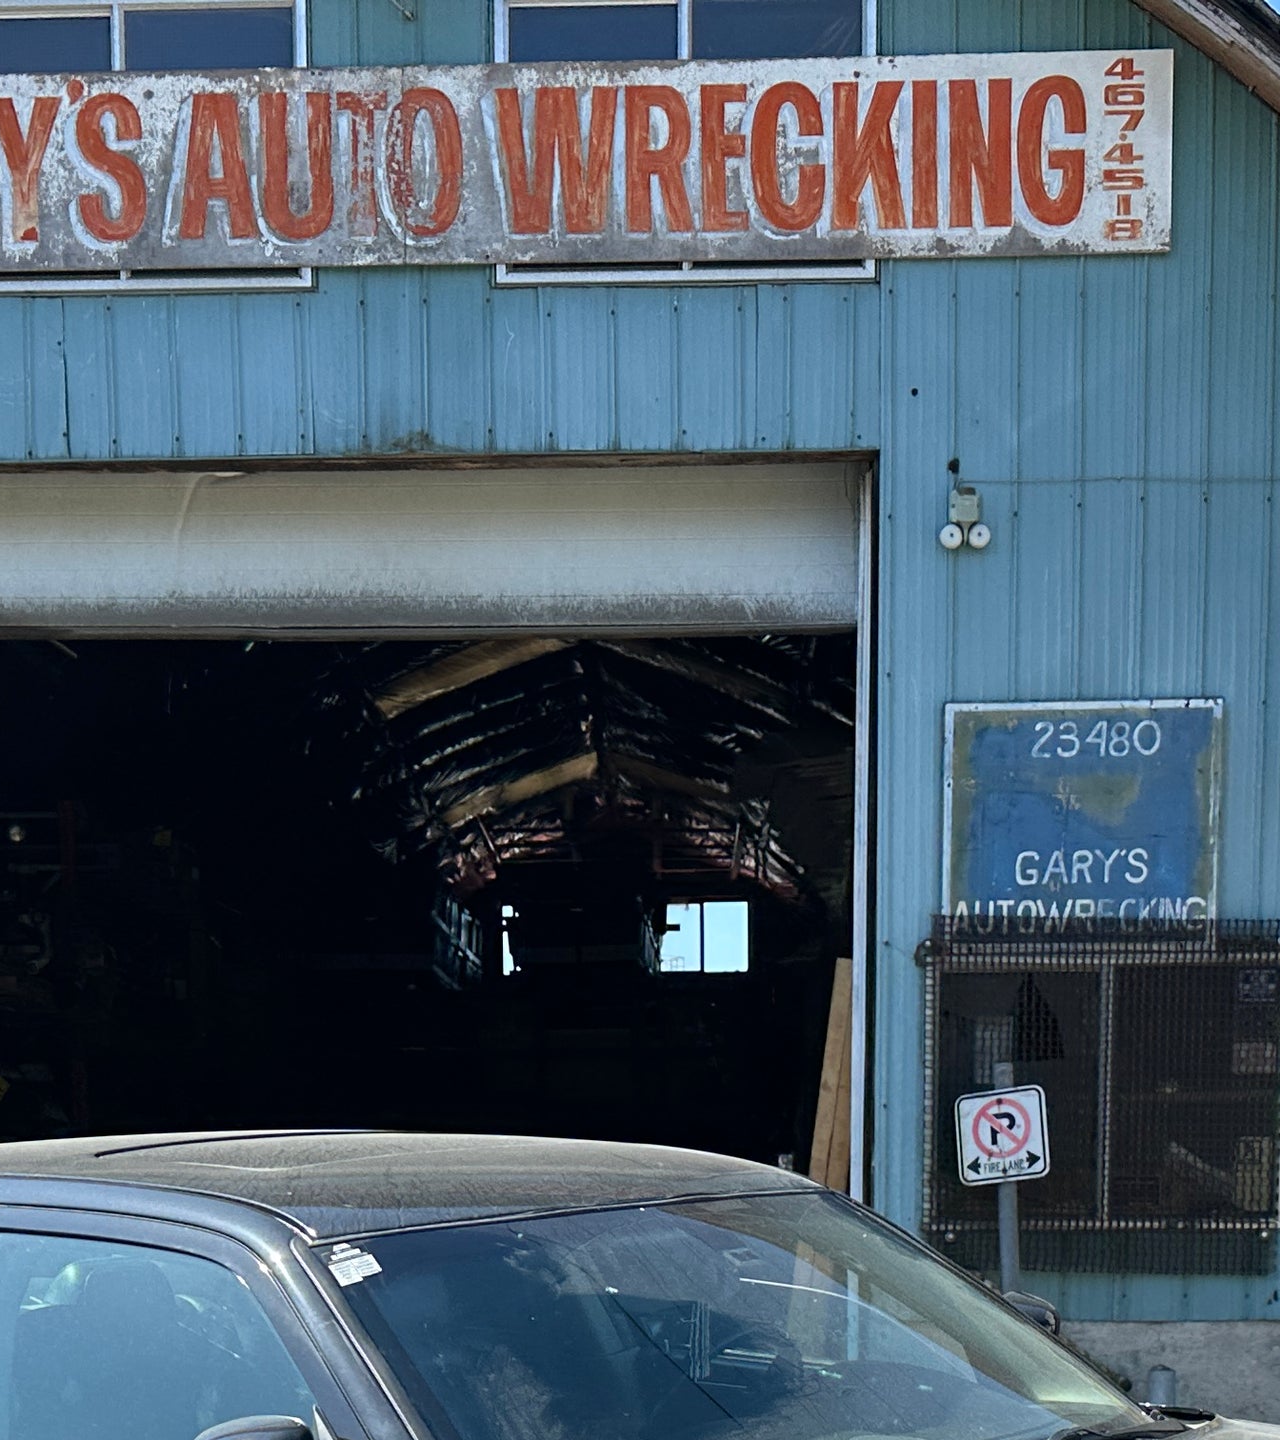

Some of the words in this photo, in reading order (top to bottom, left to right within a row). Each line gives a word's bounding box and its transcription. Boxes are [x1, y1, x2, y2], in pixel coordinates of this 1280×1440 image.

[179, 88, 463, 241] AUTO
[495, 75, 1087, 236] WRECKING
[1031, 719, 1161, 758] 23480
[1015, 848, 1149, 886] GARY'S
